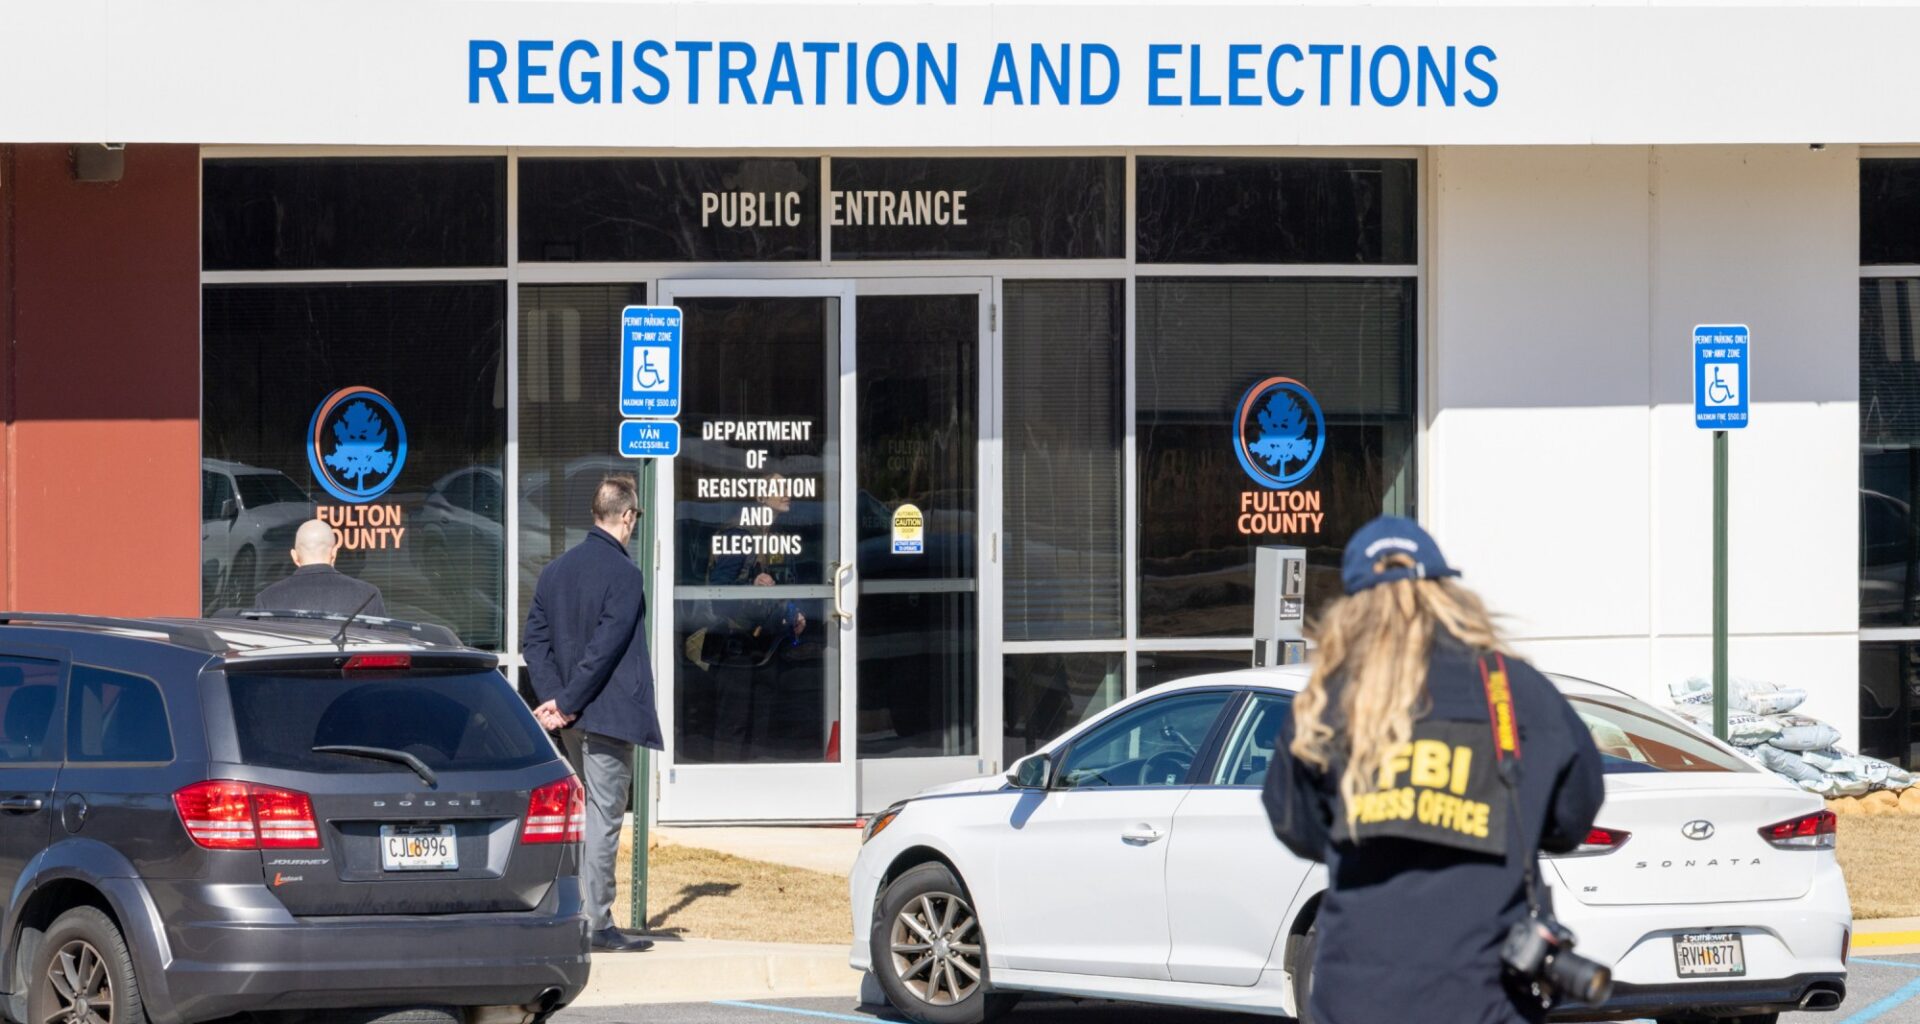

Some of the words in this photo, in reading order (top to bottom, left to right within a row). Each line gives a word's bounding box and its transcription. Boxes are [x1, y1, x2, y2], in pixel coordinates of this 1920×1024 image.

[468, 39, 958, 105] REGISTRATION
[982, 42, 1121, 106] AND
[1147, 43, 1500, 108] ELECTIONS
[702, 191, 800, 228] PUBLIC
[830, 190, 968, 226] ENTRANCE
[624, 317, 643, 327] PERMIT
[643, 316, 665, 327] PARKING
[666, 316, 680, 327] ONLY
[631, 331, 656, 342] TOW-AWAY
[657, 331, 673, 342] ZONE
[1695, 335, 1712, 344] PERMIT
[1713, 335, 1734, 344] PARKING
[1735, 335, 1747, 344] ONLY
[1702, 349, 1726, 358] TOW-AWAY
[1727, 349, 1741, 358] ZONE
[623, 398, 644, 407] MAXIMUM
[644, 398, 656, 407] FINE
[1717, 413, 1727, 421] FINE
[639, 428, 660, 440] VAN
[702, 421, 812, 441] DEPARTMENT
[629, 441, 670, 449] ACCESSIBLE
[746, 449, 768, 469] OF
[697, 478, 816, 498] REGISTRATION
[1241, 490, 1320, 512] FULTON
[316, 505, 401, 526] FULTON
[740, 506, 774, 526] AND
[1237, 512, 1325, 534] COUNTY
[331, 528, 404, 549] OUNTY
[711, 535, 802, 555] ELECTIONS
[1376, 739, 1473, 796] FBI
[373, 799, 481, 807] DODGE
[1352, 787, 1416, 824] PRESS
[1416, 788, 1491, 838] OFFICE
[389, 837, 448, 857] CJL8996
[1634, 857, 1762, 869] SONATA
[1681, 945, 1735, 966] RVH1877
